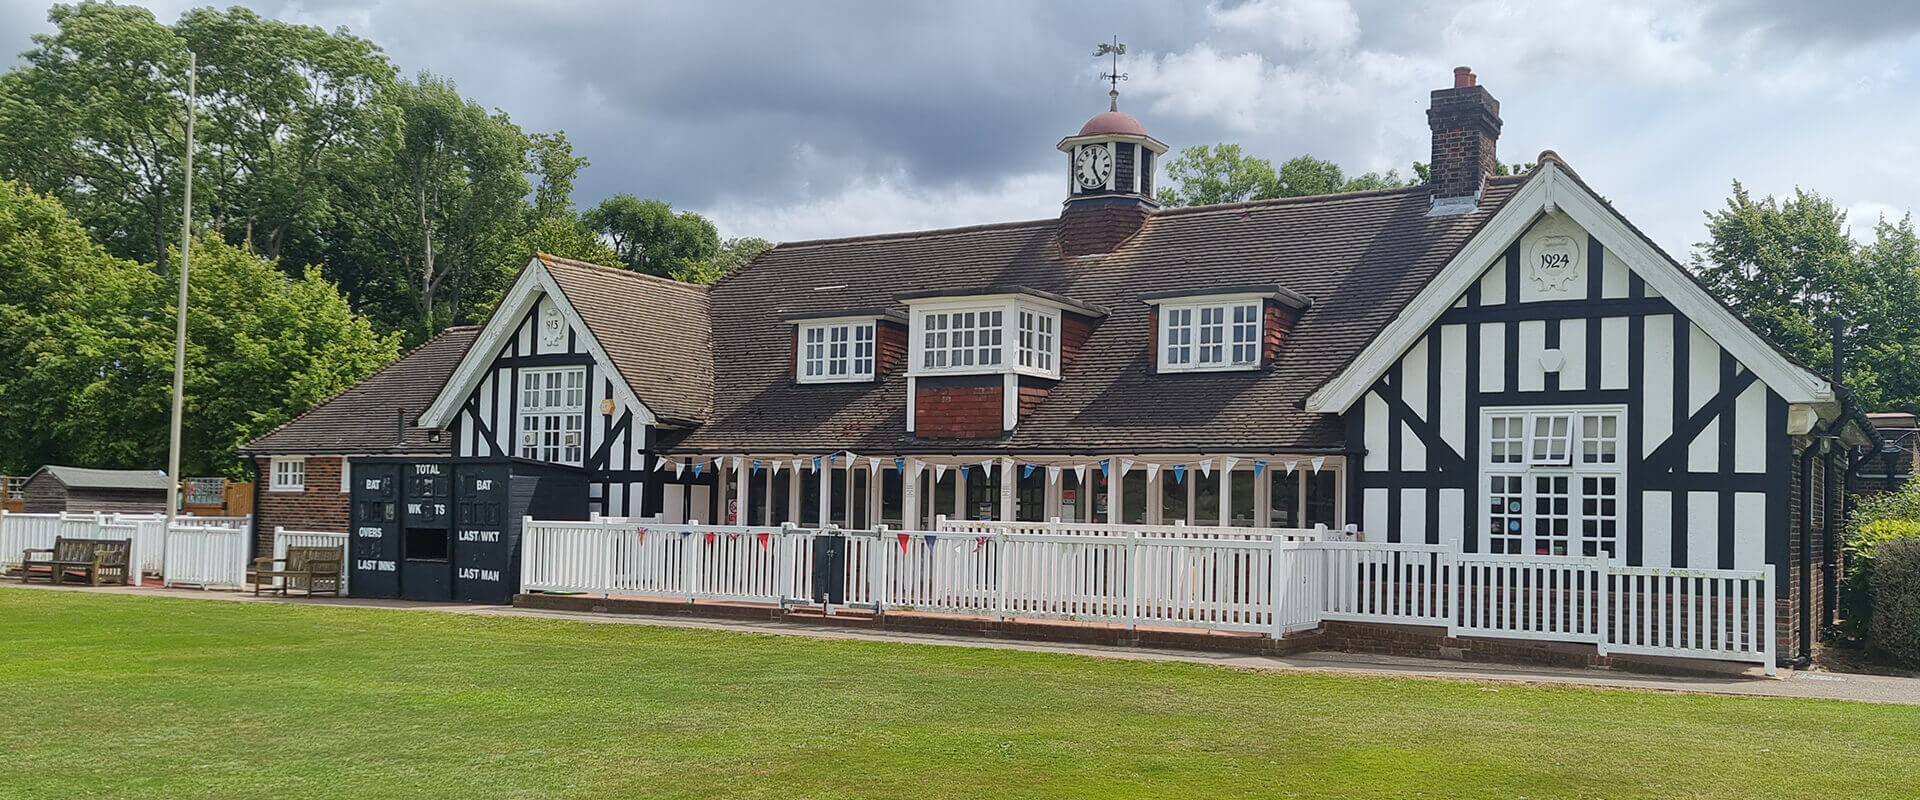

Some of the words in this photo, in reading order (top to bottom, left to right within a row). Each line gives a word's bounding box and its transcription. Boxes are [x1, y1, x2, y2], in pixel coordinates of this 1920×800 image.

[1542, 254, 1570, 270] 1924
[416, 464, 440, 474] TOTAL
[366, 480, 382, 490] BAT
[476, 480, 492, 490] BAT
[408, 504, 422, 514] WK
[434, 504, 446, 516] TS
[358, 526, 382, 538] OVERS
[458, 530, 480, 542] LAST
[480, 530, 500, 542] WKT
[358, 560, 376, 570] LAST
[378, 560, 396, 572] INNS
[458, 568, 480, 580] LAST
[480, 570, 500, 582] MAN
